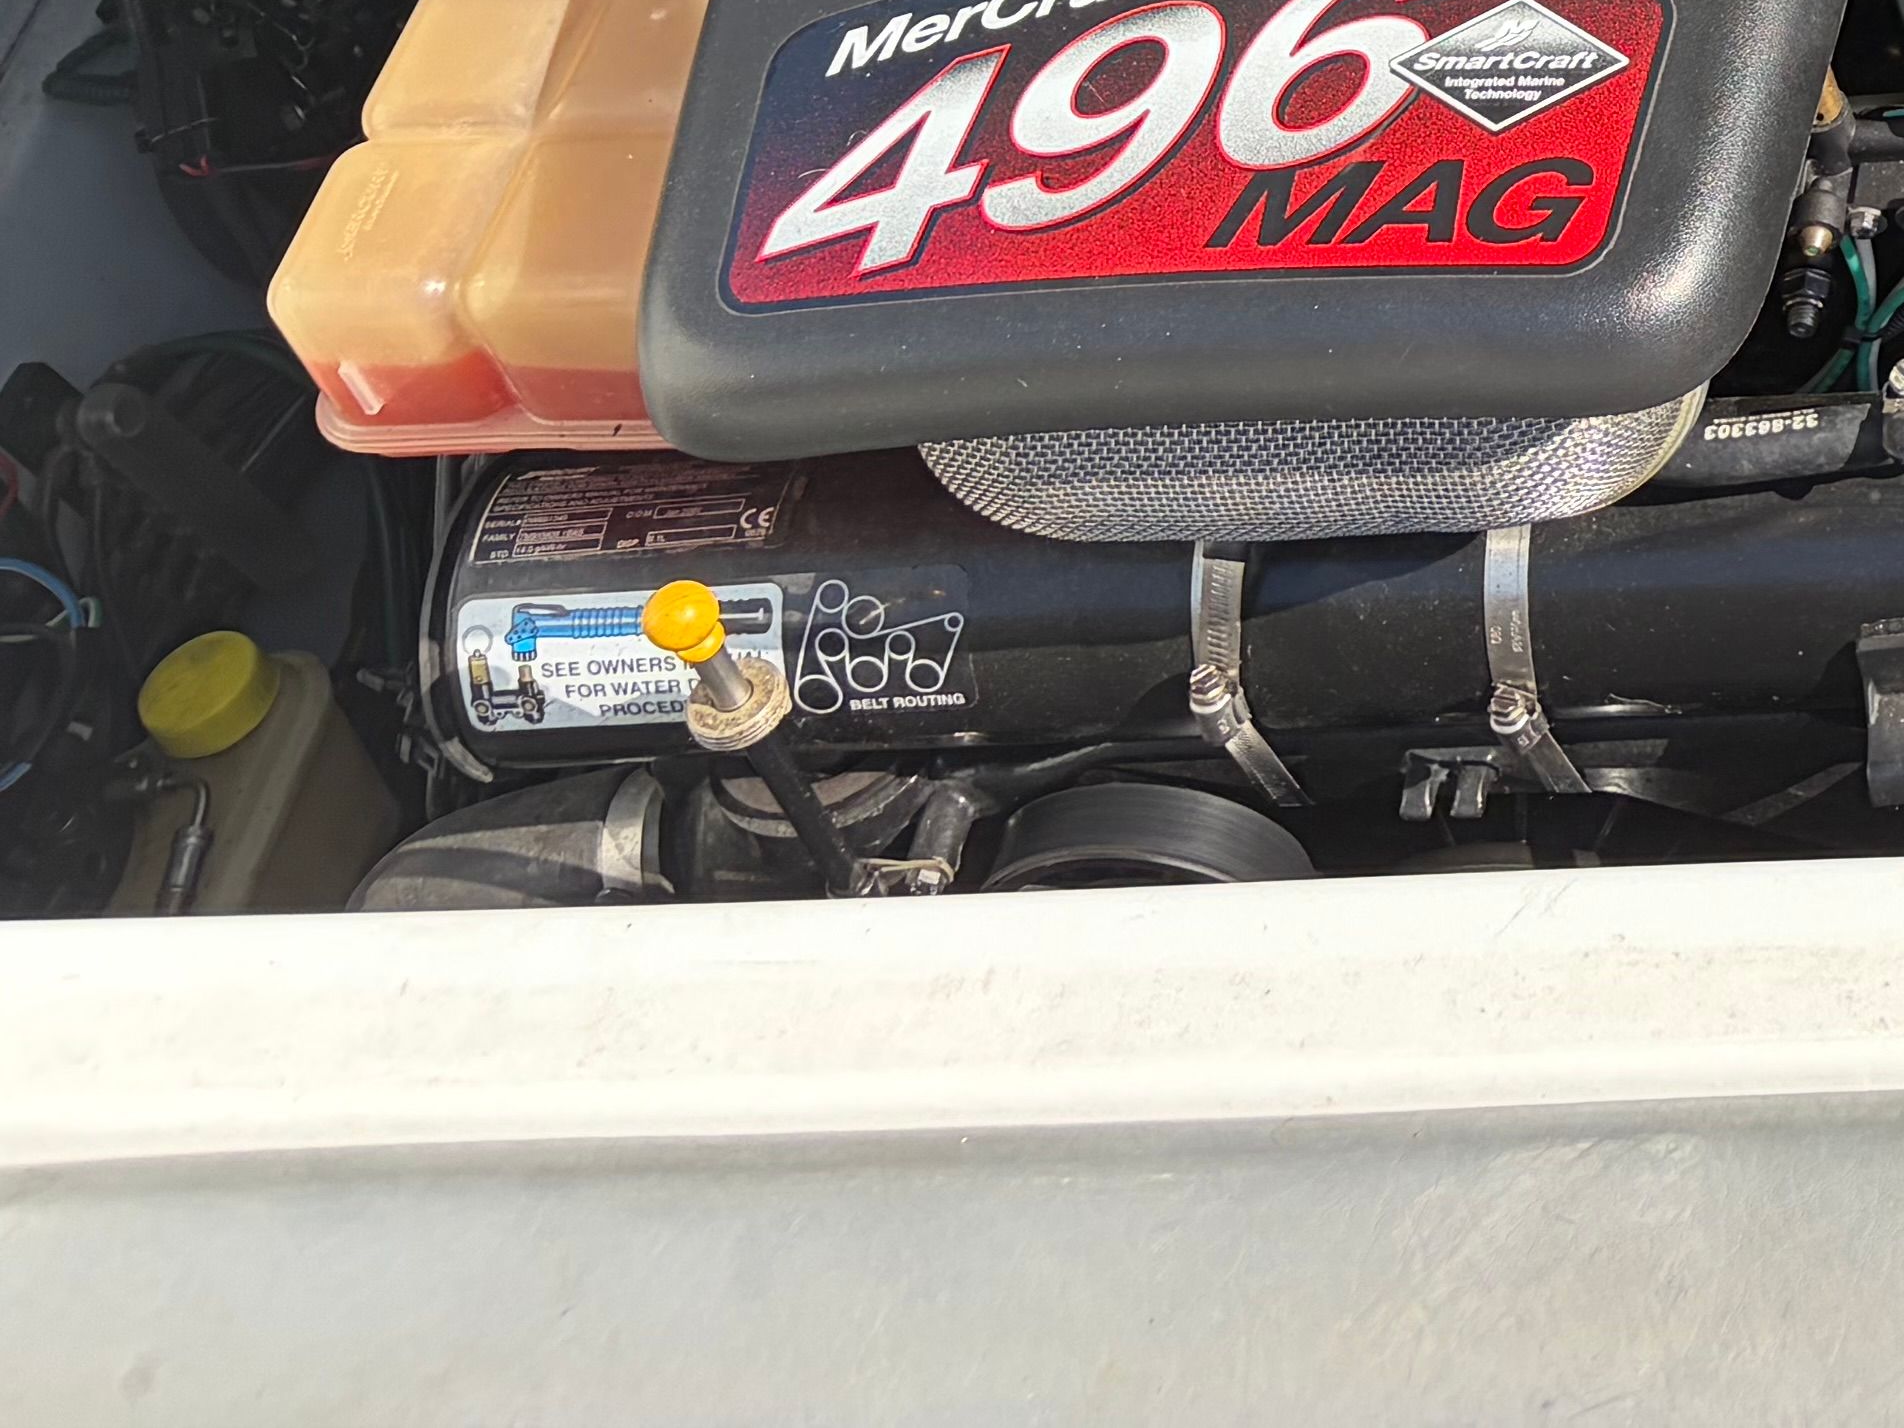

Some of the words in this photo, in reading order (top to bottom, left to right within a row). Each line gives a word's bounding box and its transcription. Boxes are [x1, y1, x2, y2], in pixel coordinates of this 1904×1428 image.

[1413, 51, 1599, 71] SmartCraft
[1444, 75, 1515, 88] Integrated
[1517, 75, 1565, 87] Marine
[1463, 88, 1542, 102] Technology
[1203, 155, 1596, 252] MAG
[739, 507, 776, 529] CE
[540, 661, 582, 679] SEE
[586, 656, 677, 675] OWNERS
[564, 682, 607, 699] FOR
[610, 678, 682, 696] WATER
[849, 697, 890, 711] BELT
[892, 692, 967, 709] ROUTING
